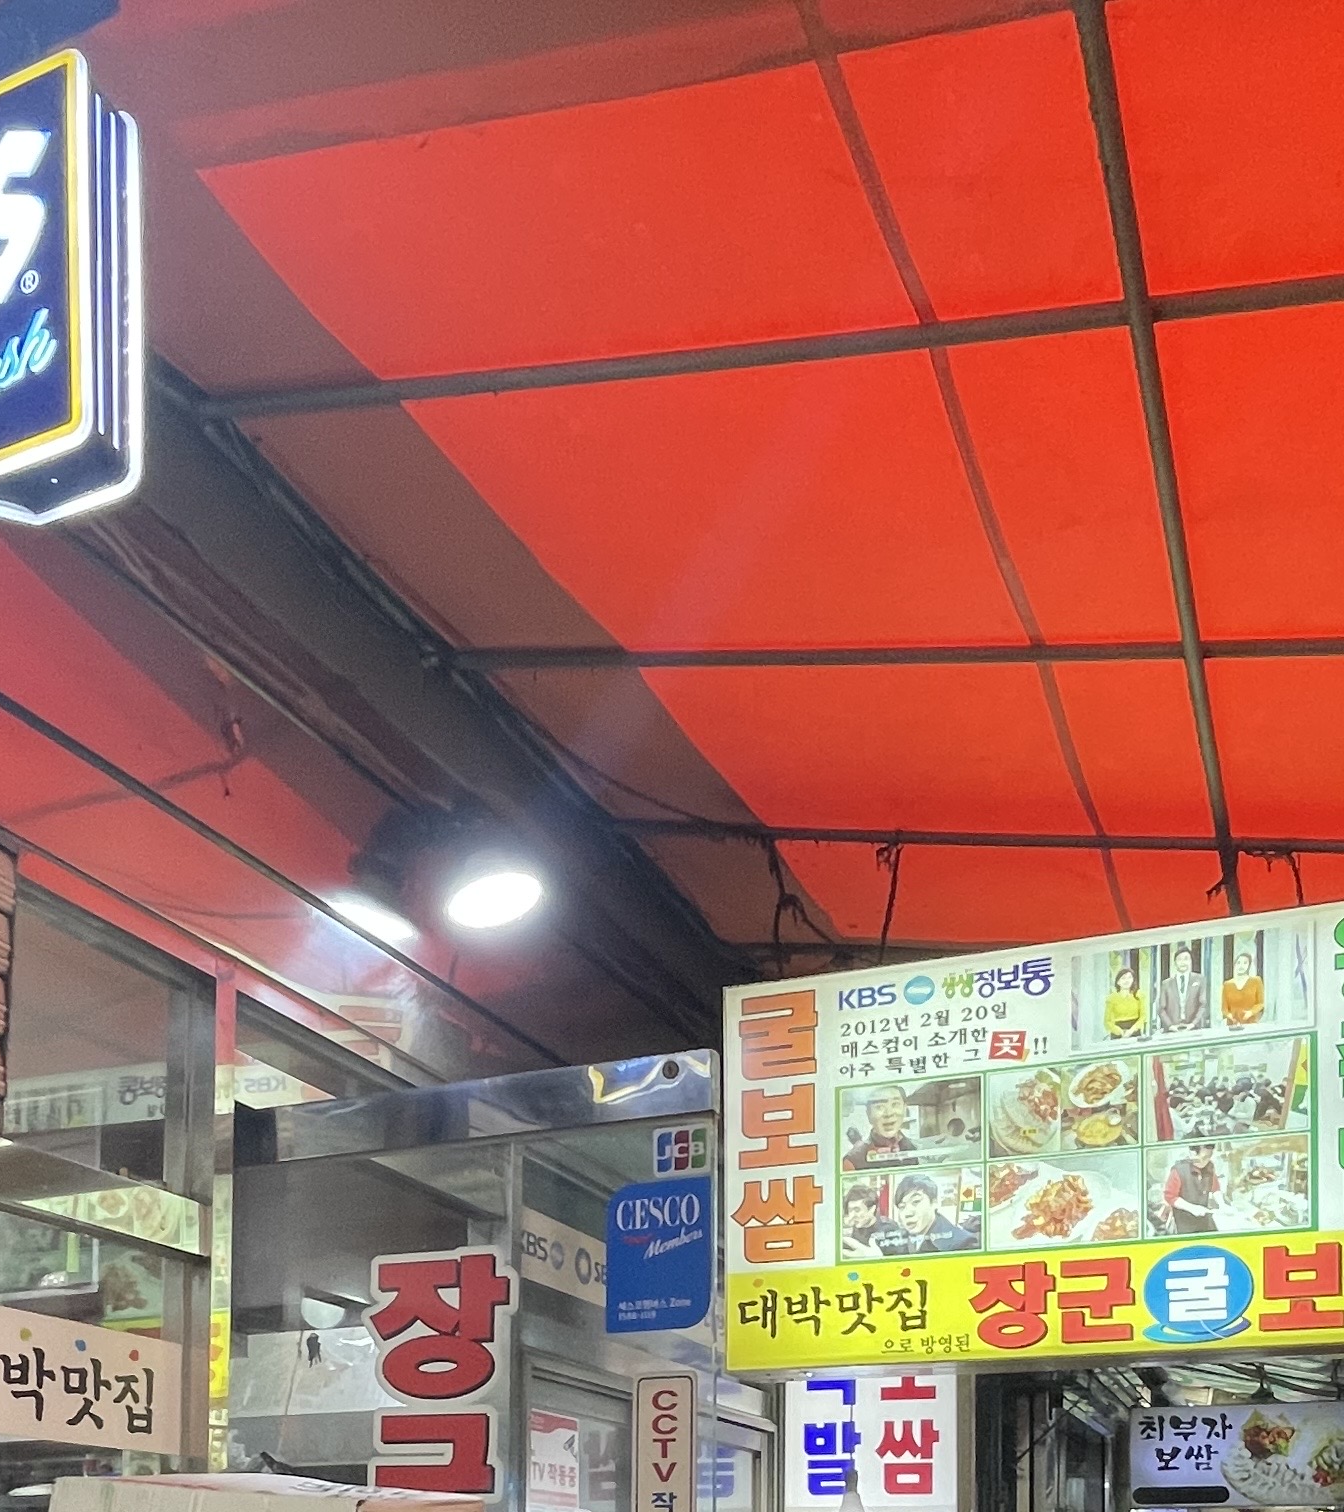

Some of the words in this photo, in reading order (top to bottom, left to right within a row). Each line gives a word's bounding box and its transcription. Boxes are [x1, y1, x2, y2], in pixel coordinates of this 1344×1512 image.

[838, 983, 897, 1011] KBS
[840, 1016, 909, 1038] 2012년
[920, 1010, 951, 1028] 2월
[961, 1002, 1008, 1020] 20일
[840, 1034, 919, 1059] 매스컴이
[927, 1027, 988, 1047] 소개한
[839, 1060, 876, 1080] 아주
[884, 1053, 950, 1075] 특별한
[963, 1048, 982, 1062] 그
[731, 988, 823, 1265] 굴보쌈
[657, 1141, 704, 1160] JCB
[616, 1193, 701, 1232] CESCO
[643, 1228, 704, 1260] Members
[737, 1279, 929, 1340] 대박맛집
[651, 1389, 679, 1483] CCTV
[1138, 1413, 1233, 1441] 최부자
[1155, 1444, 1220, 1472] 보쌈
